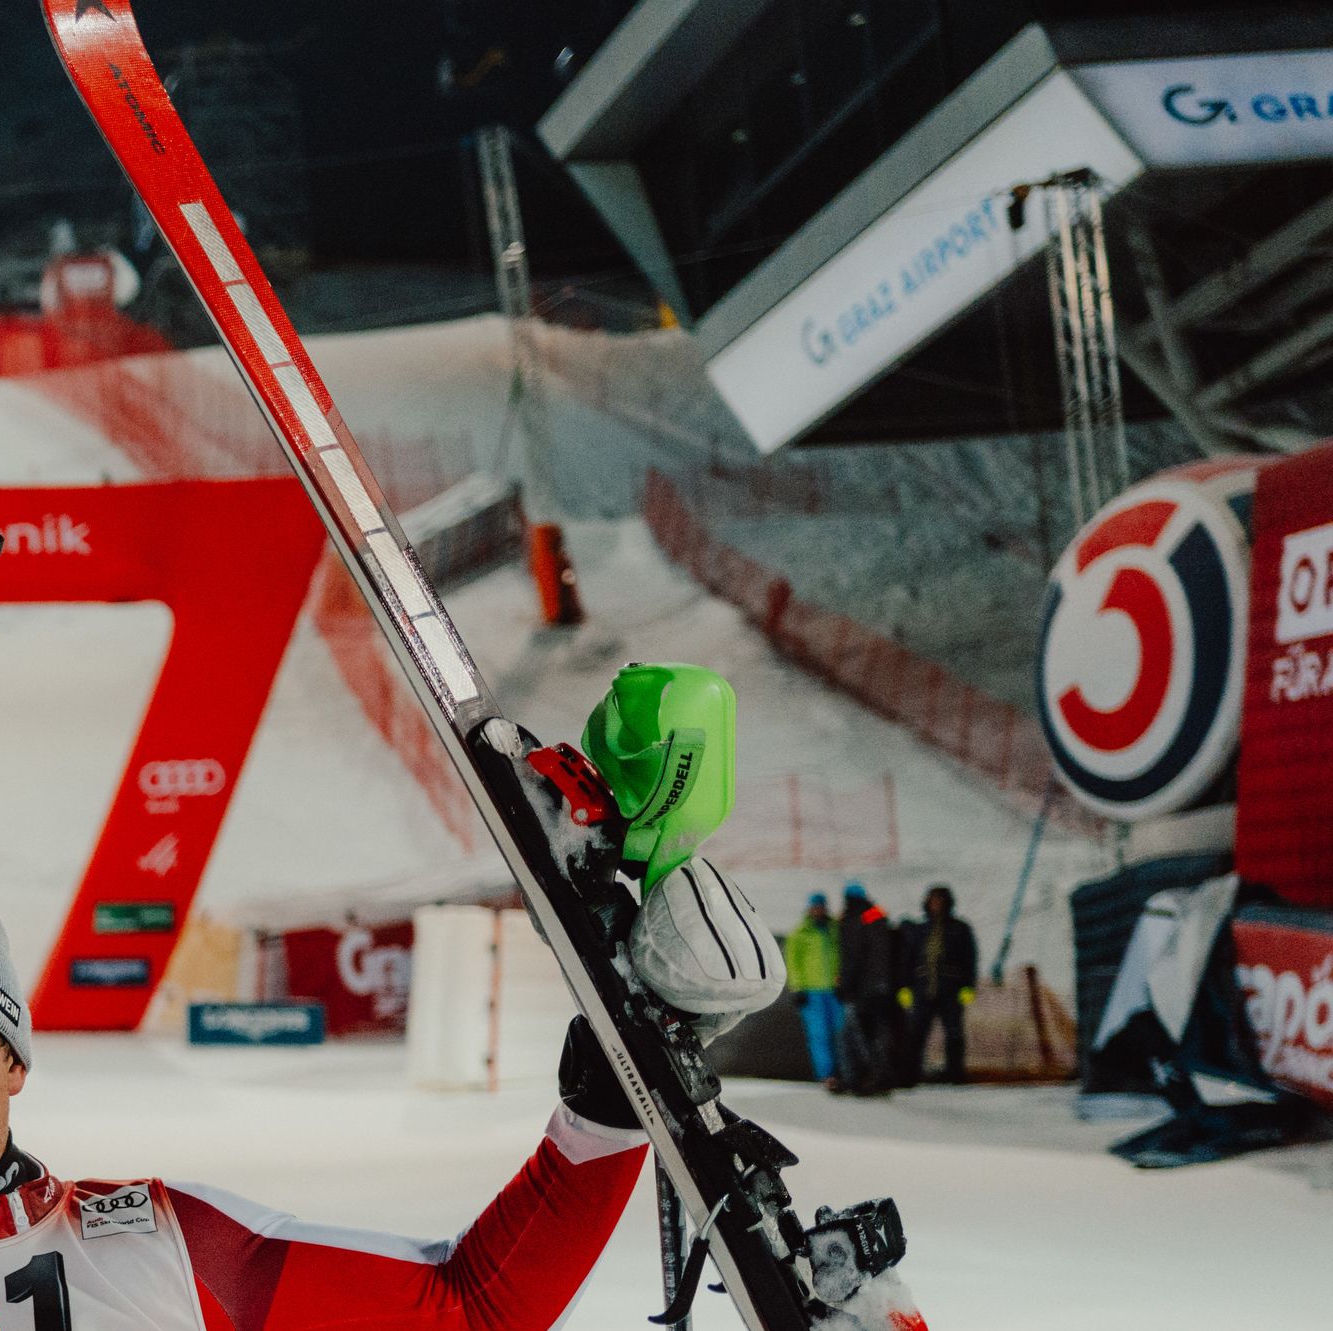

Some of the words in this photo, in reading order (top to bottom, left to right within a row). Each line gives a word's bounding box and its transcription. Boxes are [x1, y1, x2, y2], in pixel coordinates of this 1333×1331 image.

[109, 64, 166, 155] ATOMIC
[1251, 92, 1333, 123] GR
[617, 1052, 654, 1116] ULTRAWALL
